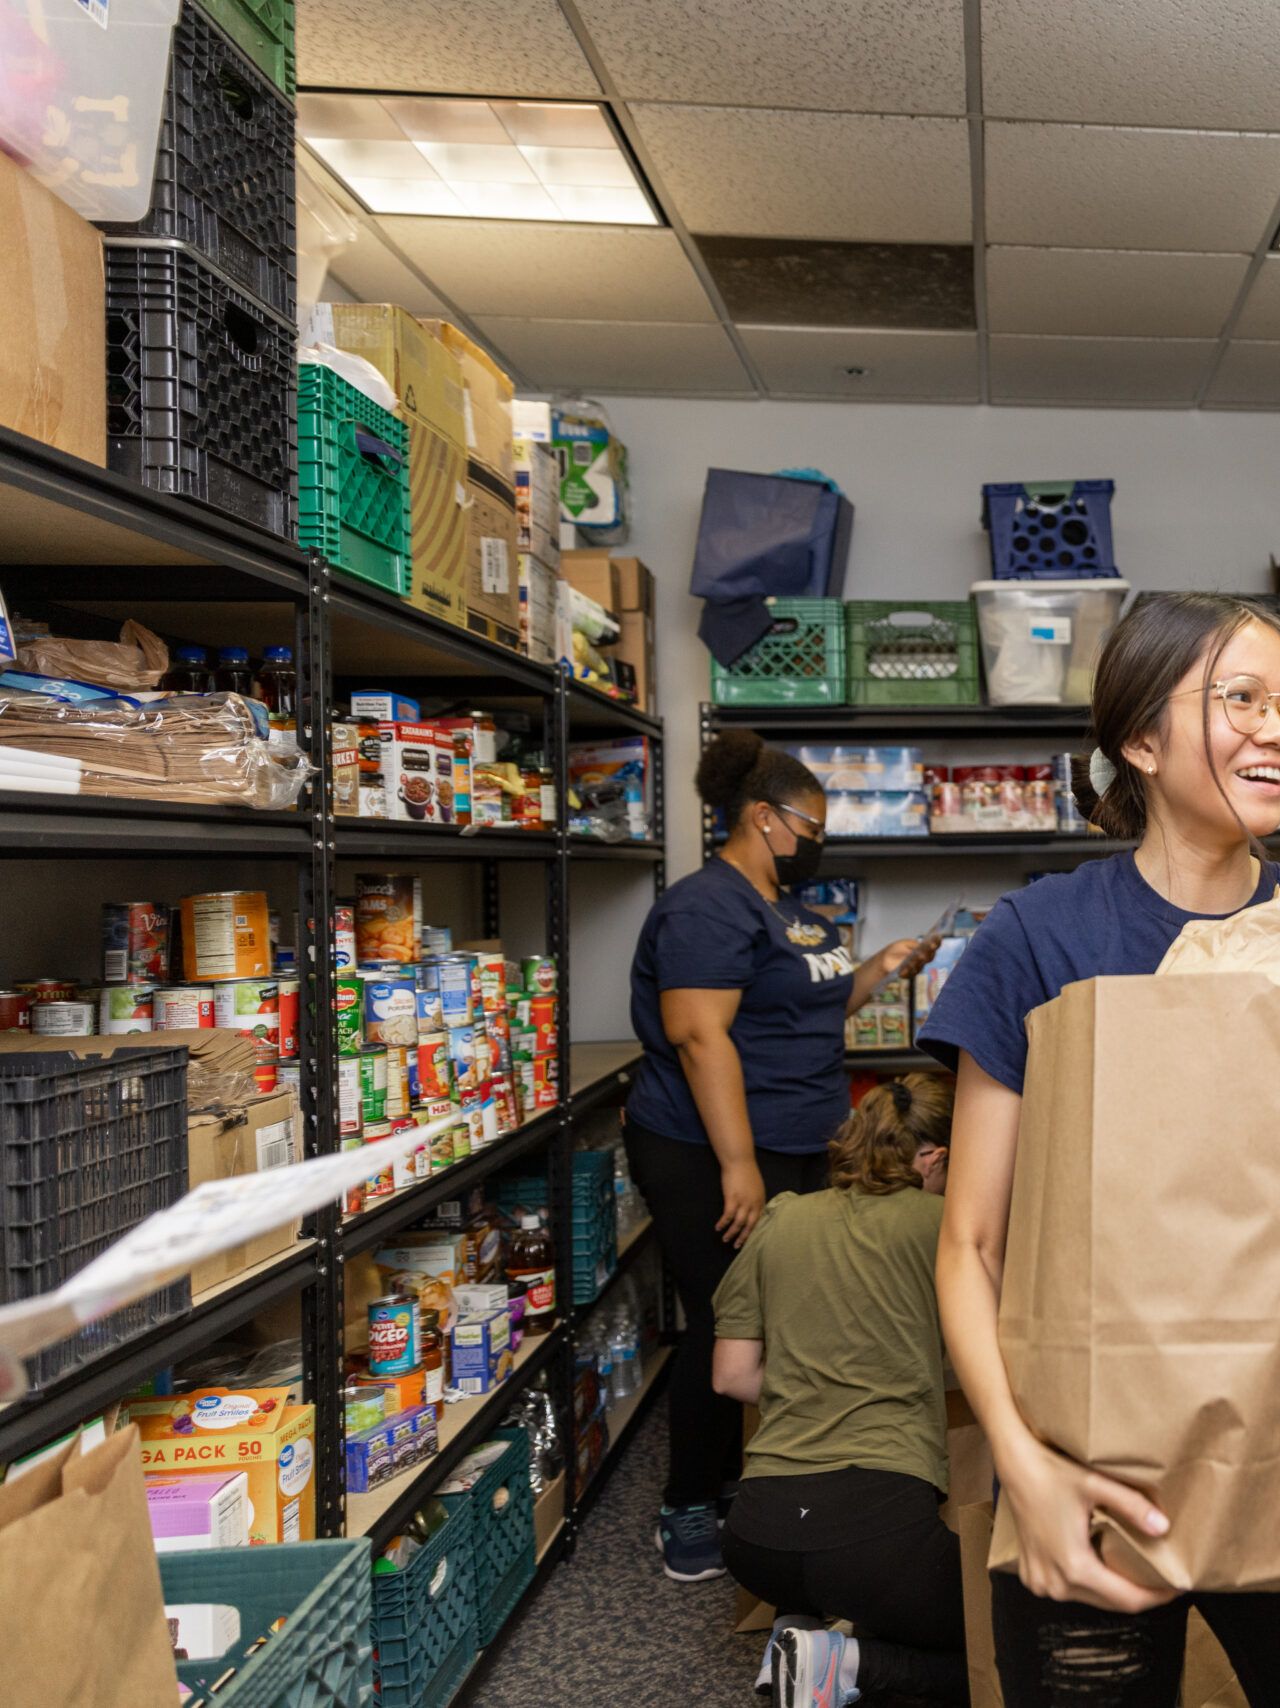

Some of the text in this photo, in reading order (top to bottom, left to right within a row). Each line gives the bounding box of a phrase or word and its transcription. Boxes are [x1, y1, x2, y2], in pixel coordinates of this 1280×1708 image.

[219, 1409, 249, 1417] Smiles
[174, 1445, 226, 1462] PACK
[238, 1441, 262, 1456] 50
